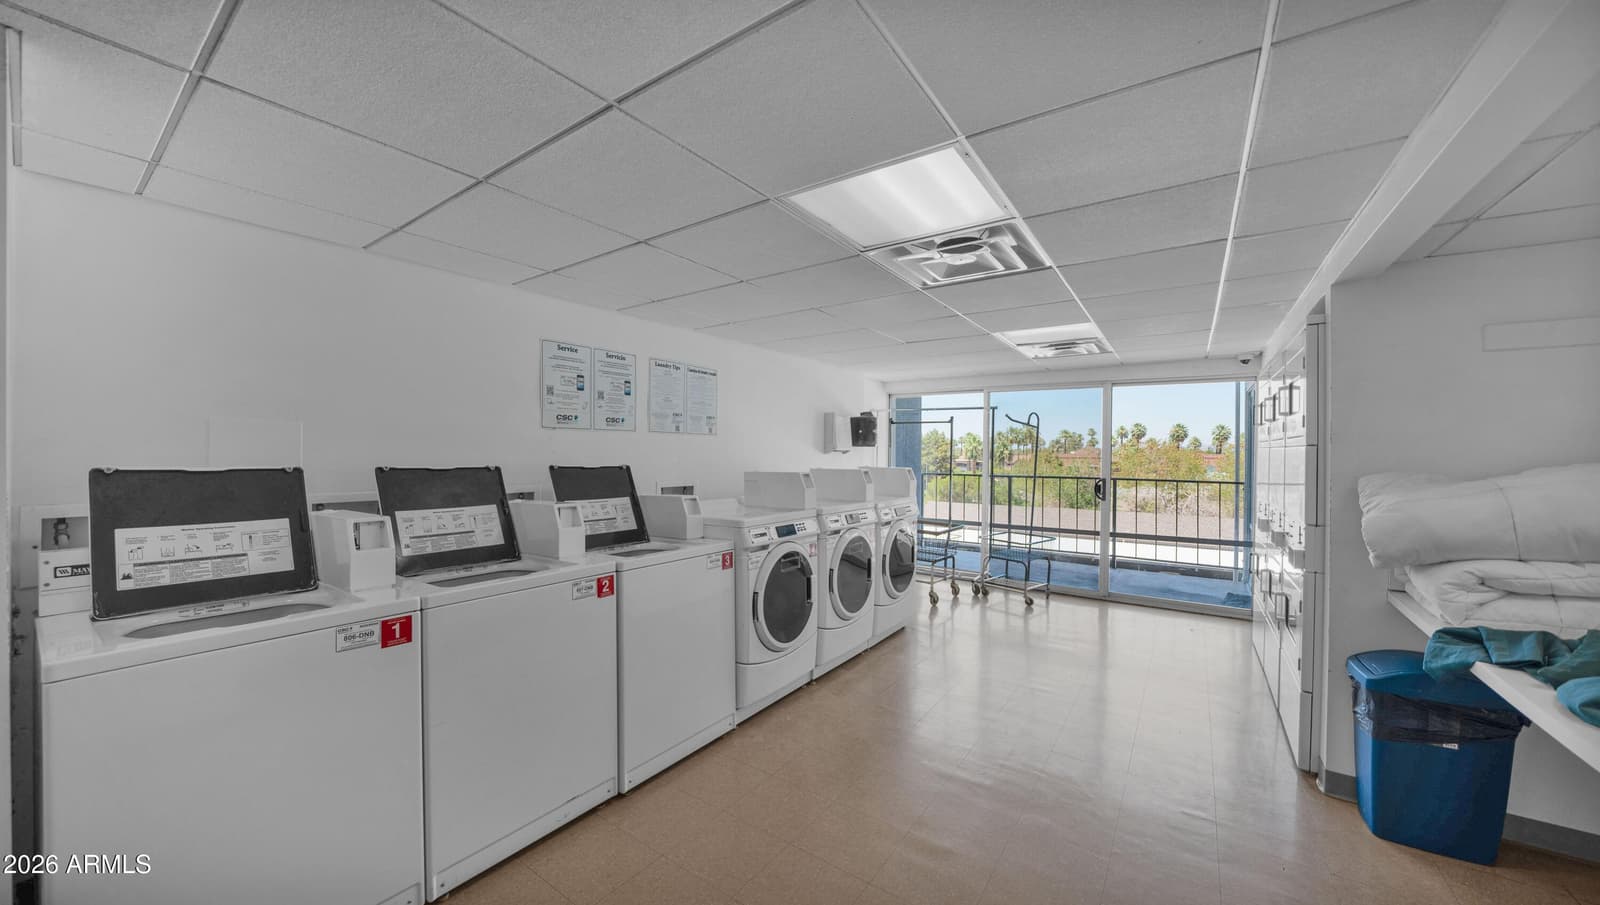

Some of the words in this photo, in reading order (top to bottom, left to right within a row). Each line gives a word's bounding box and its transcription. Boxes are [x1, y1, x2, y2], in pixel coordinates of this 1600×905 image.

[557, 344, 578, 353] Service
[606, 352, 626, 361] Servicio
[725, 555, 730, 566] 3
[602, 580, 609, 593] 2
[391, 622, 400, 639] 1
